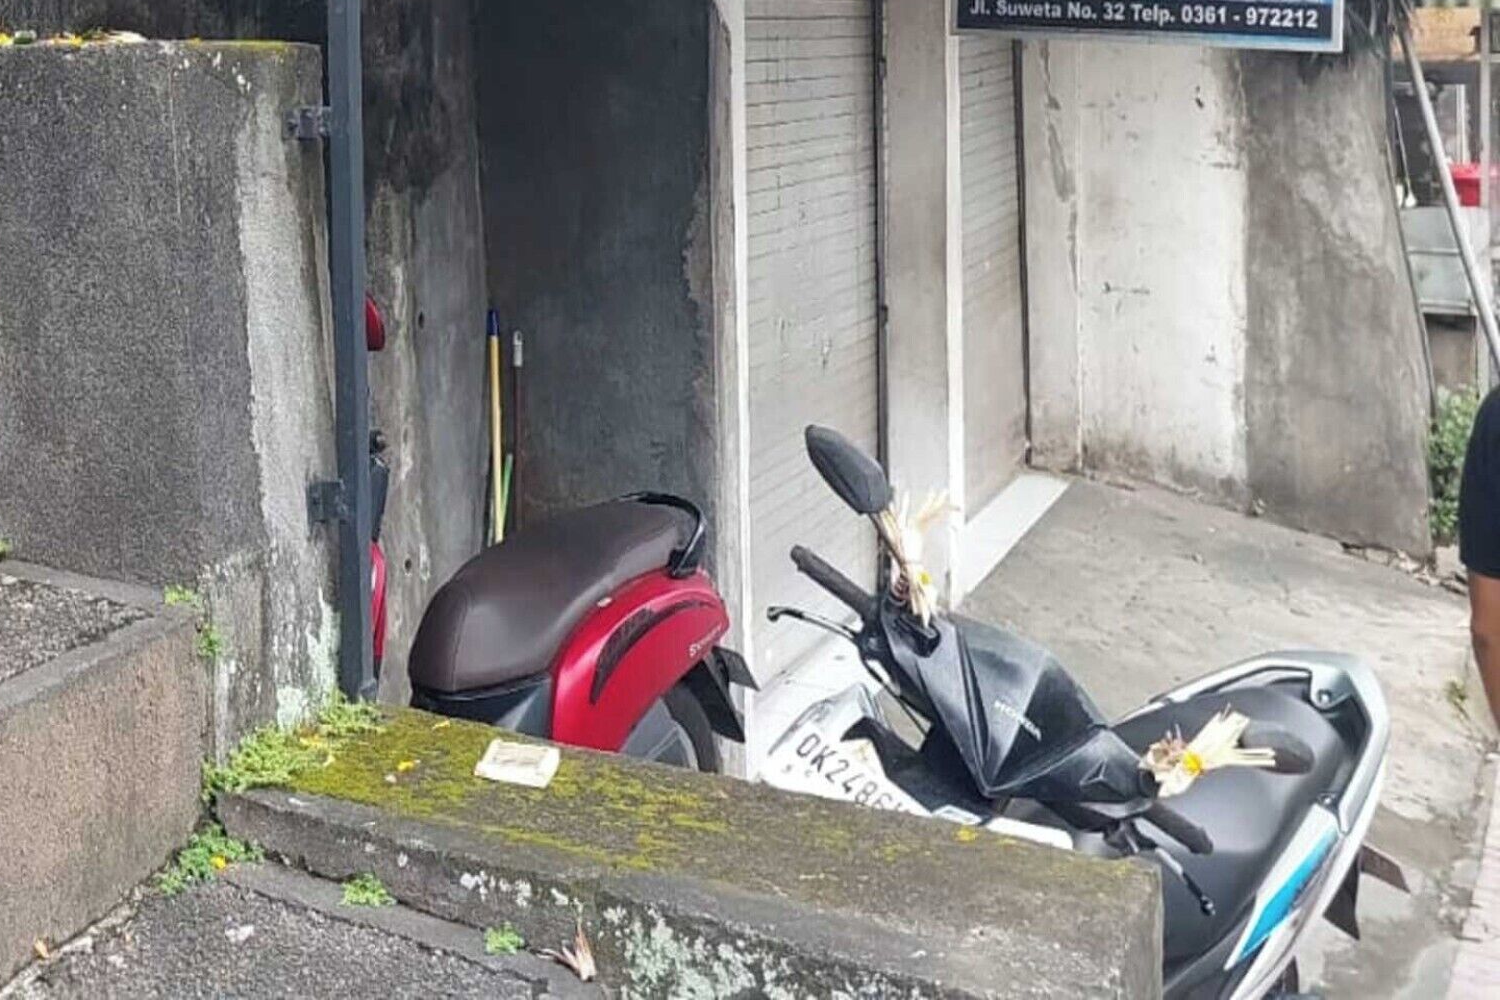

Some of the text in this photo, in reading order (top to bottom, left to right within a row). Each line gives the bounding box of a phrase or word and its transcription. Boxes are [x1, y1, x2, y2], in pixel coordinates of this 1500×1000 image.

[1067, 1, 1098, 20] No.
[1102, 3, 1125, 21] 32
[1130, 3, 1176, 27] Telp.
[1180, 4, 1228, 25] 0361
[1245, 6, 1319, 29] 972212
